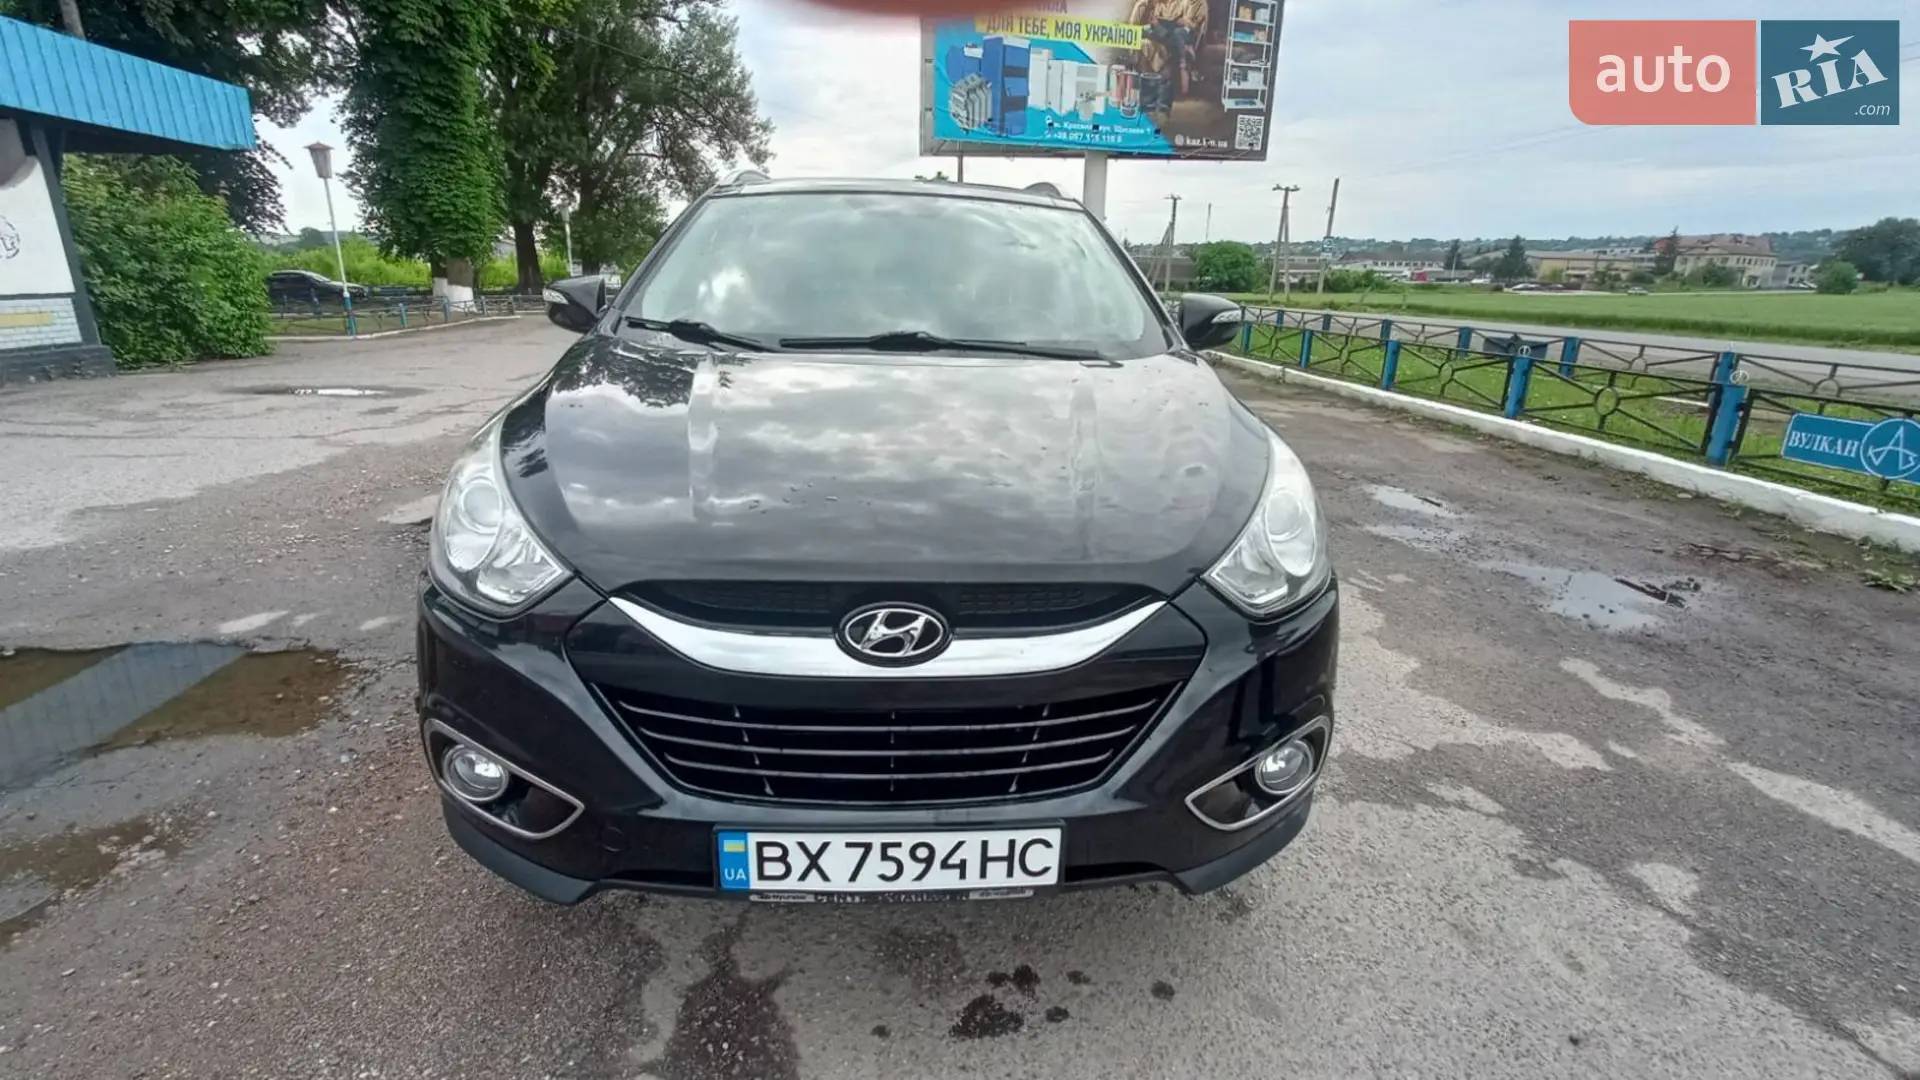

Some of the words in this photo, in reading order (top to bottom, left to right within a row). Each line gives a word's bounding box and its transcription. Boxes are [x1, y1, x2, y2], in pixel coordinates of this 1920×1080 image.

[1019, 16, 1050, 38] ТЕБЕ,
[1054, 19, 1081, 40] МОЯ
[1085, 23, 1138, 46] УКРАЇНО!
[1788, 430, 1860, 457] ВУЛКАН
[724, 868, 747, 881] UA
[756, 840, 832, 883] BX
[845, 840, 967, 883] 7594
[979, 838, 1054, 879] HC
